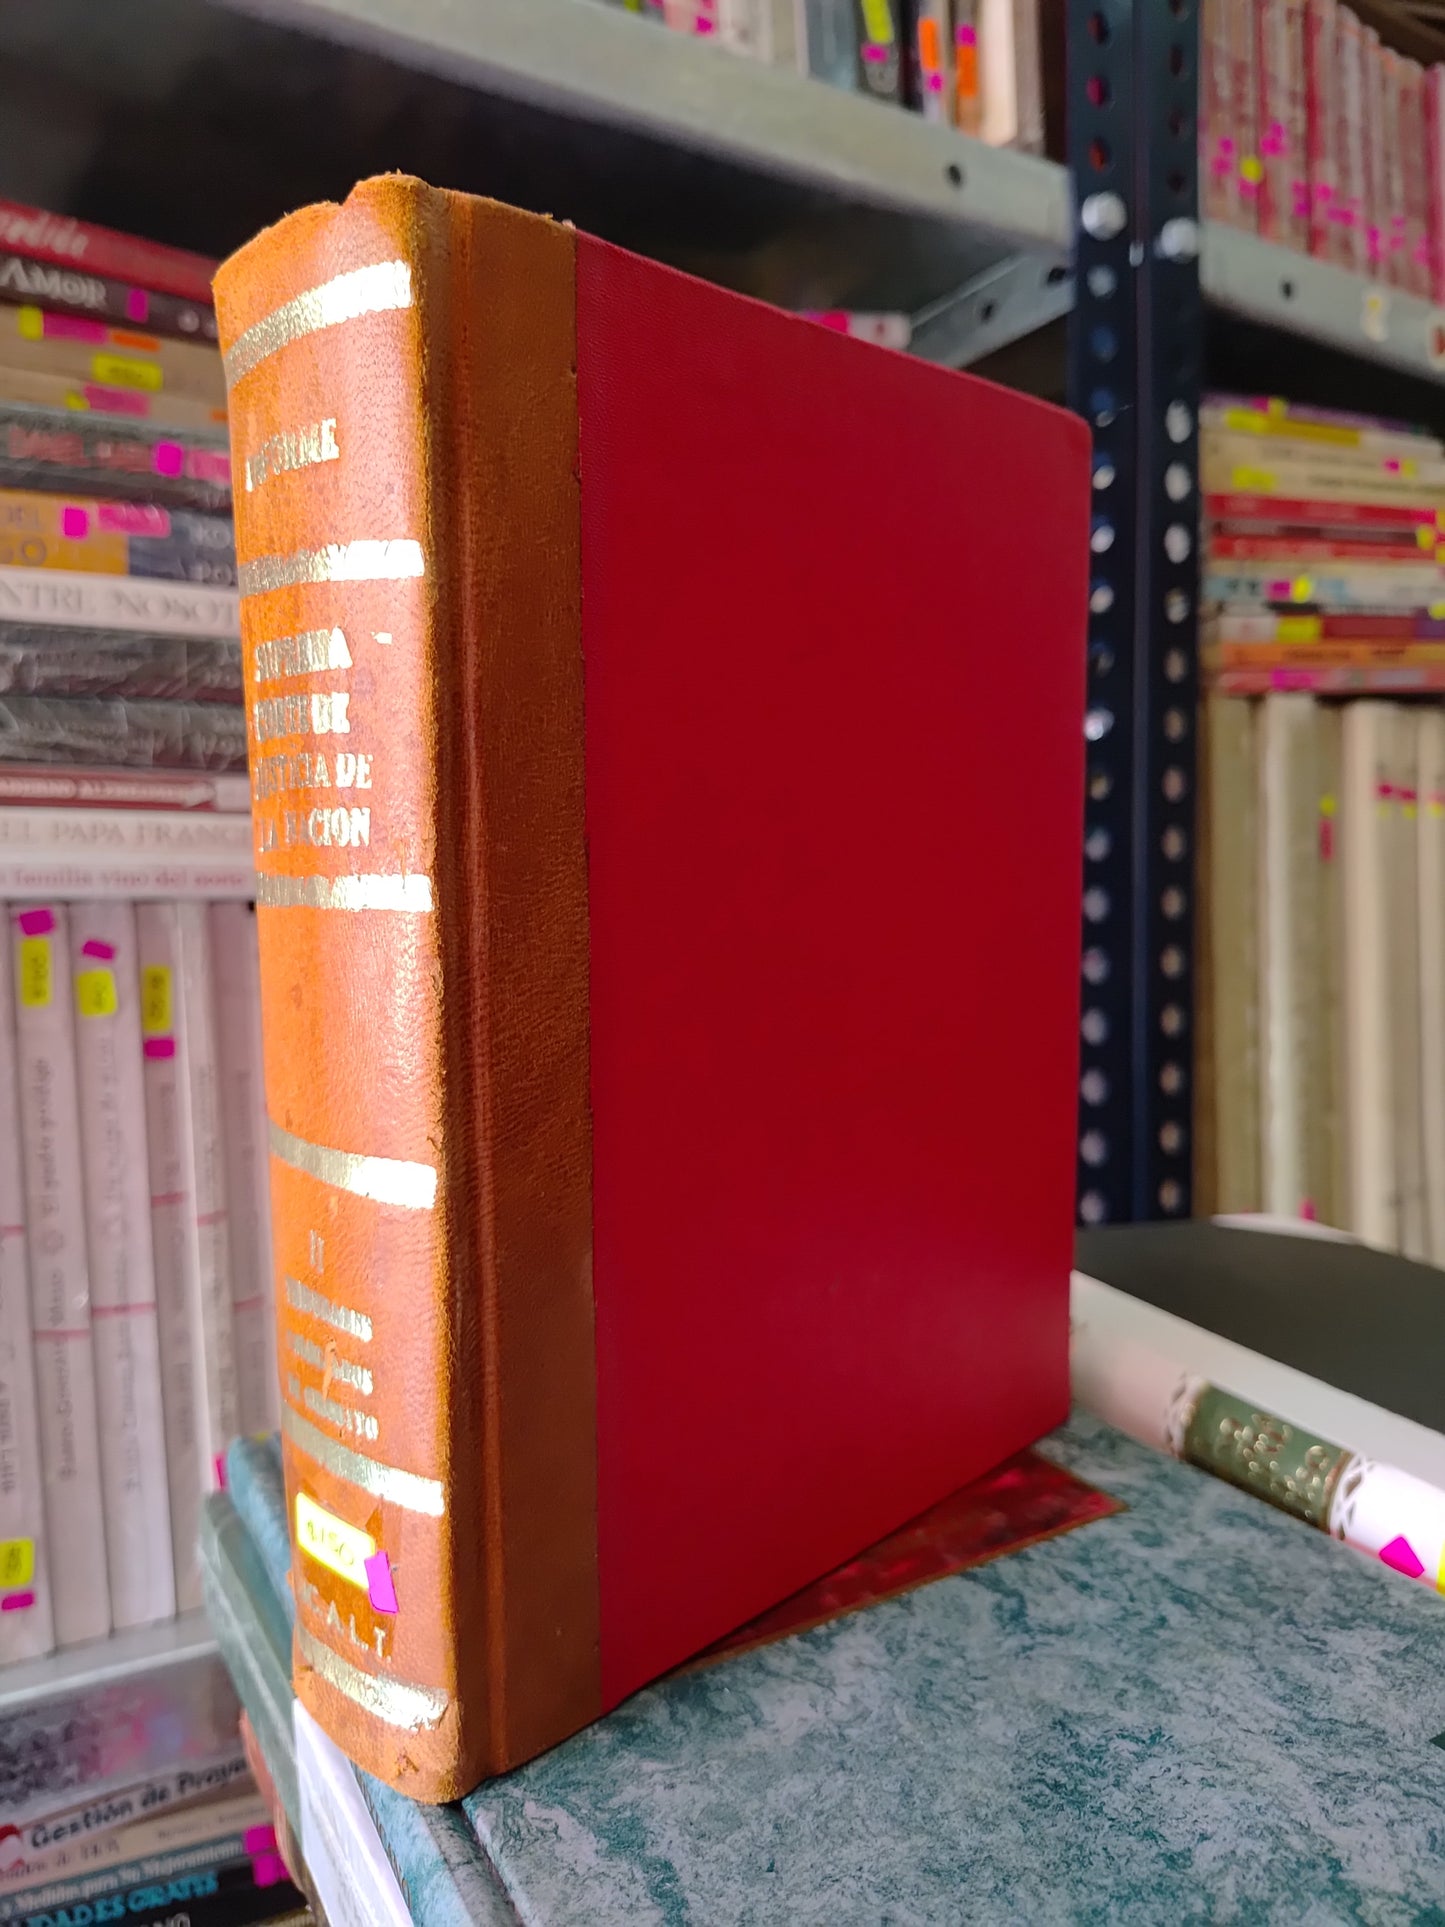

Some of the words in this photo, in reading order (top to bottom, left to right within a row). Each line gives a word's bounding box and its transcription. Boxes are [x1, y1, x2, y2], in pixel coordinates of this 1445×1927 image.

[336, 752, 374, 789] DE
[53, 821, 125, 845] PAPA
[28, 1797, 134, 1849] Gestión
[140, 1783, 170, 1807] de
